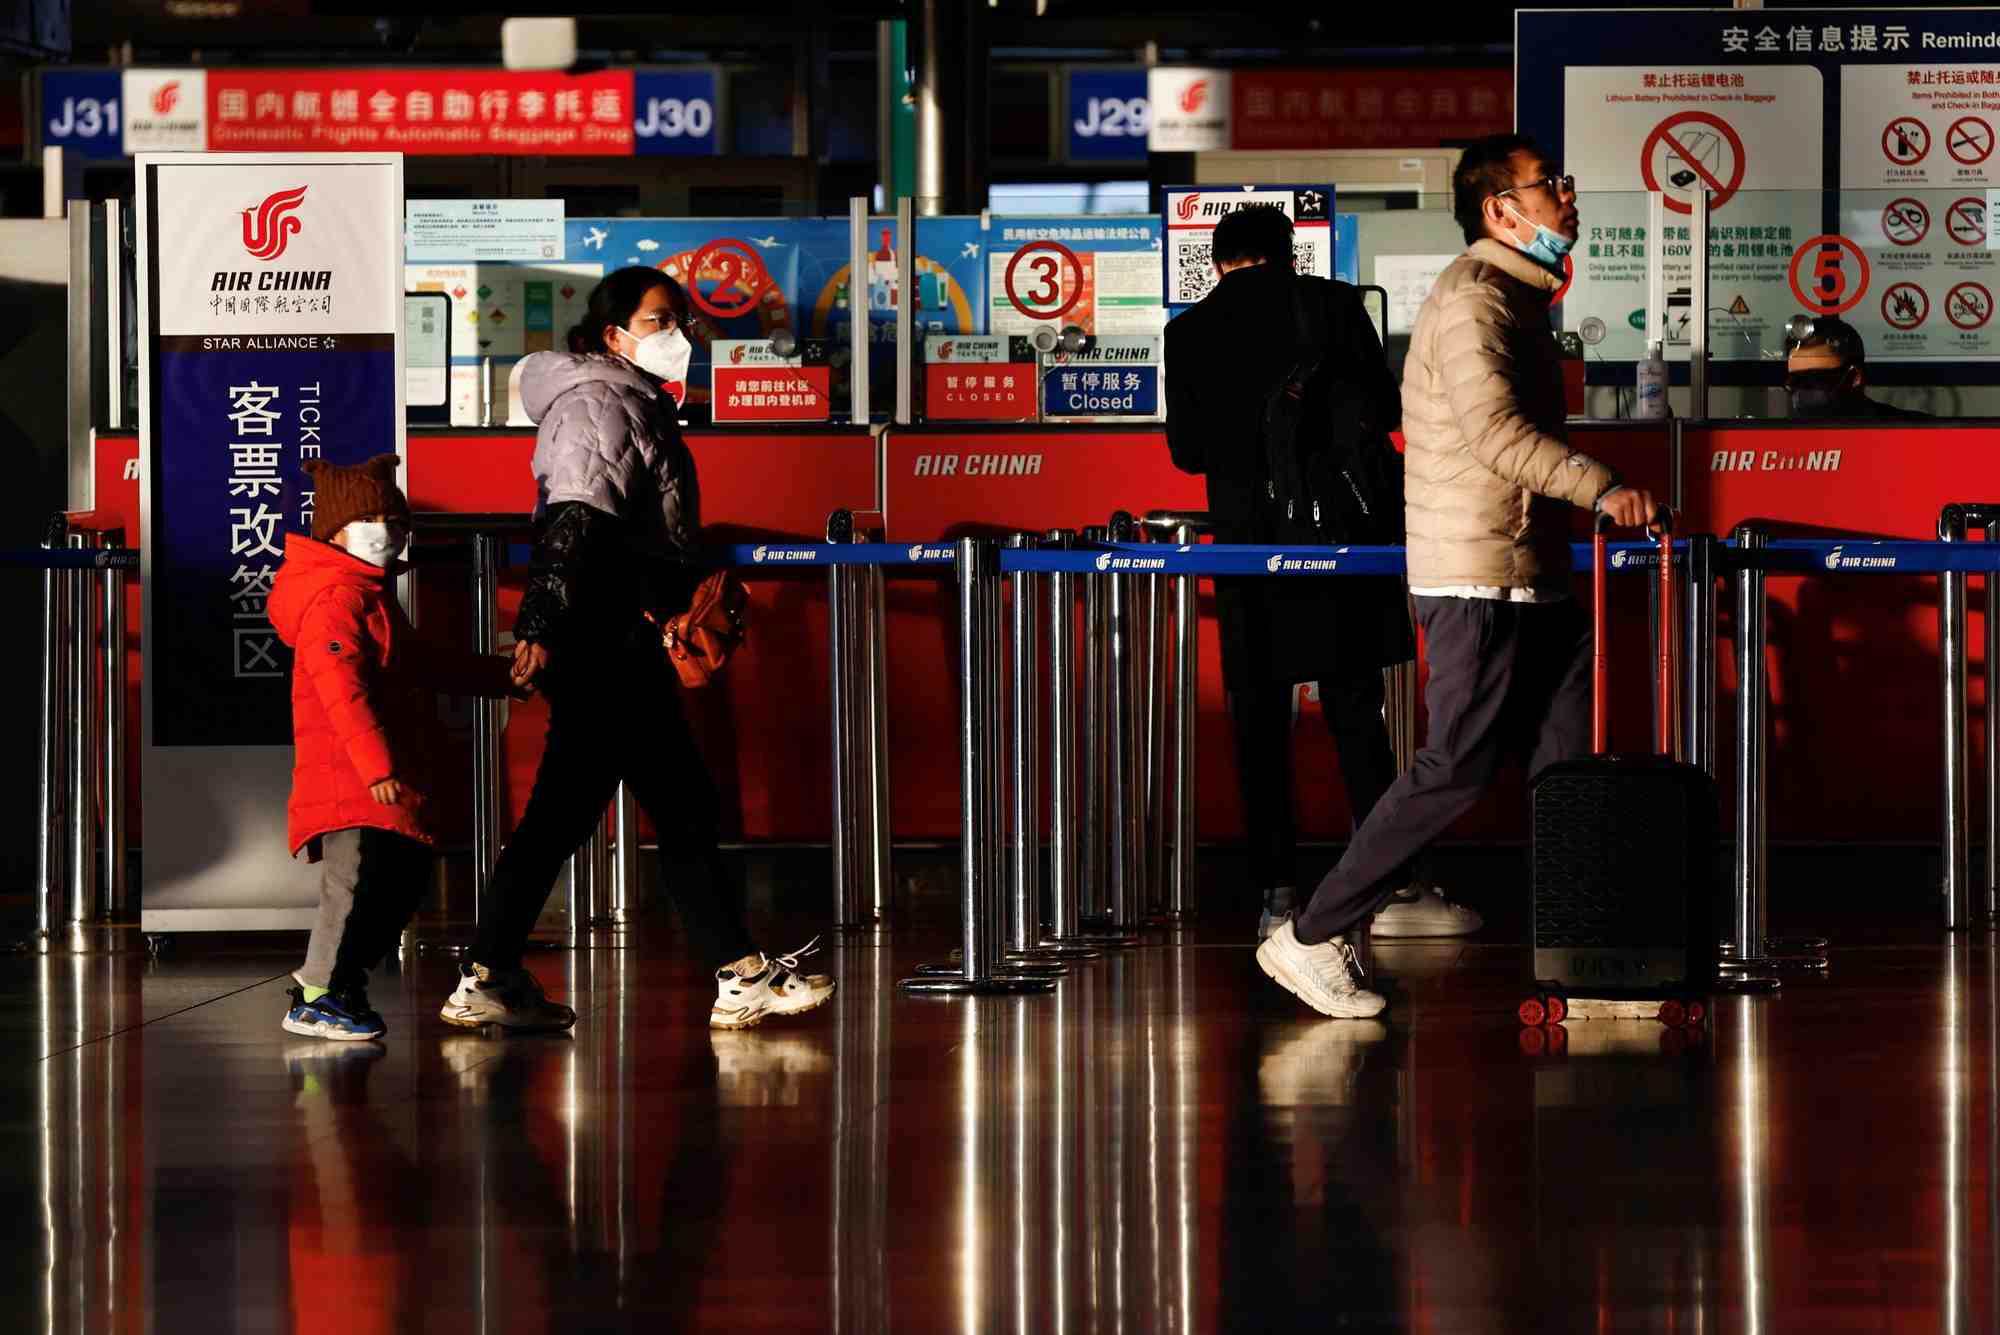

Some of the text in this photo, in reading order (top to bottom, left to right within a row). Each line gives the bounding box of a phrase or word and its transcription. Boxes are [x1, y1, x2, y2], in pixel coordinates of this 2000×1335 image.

[1722, 25, 1911, 52] 安全信息提示
[1643, 73, 1744, 88] 禁止托运锂电池
[1908, 70, 2000, 84] 禁止托运或随
[218, 88, 623, 122] 国内航班全自助行李托运
[1982, 102, 2000, 111] Bagg
[51, 97, 118, 137] J31
[634, 98, 712, 137] J30
[1074, 96, 1149, 137] J29
[1202, 202, 1230, 216] AIR
[211, 271, 332, 291] AIR CHINA
[1028, 256, 1059, 305] 3
[1812, 251, 1846, 301] 5
[203, 337, 318, 350] STAR ALLIANCE
[1105, 348, 1150, 360] CHINA
[1061, 373, 1141, 391] 暂停服务
[729, 394, 817, 406] 办理国内登机牌
[946, 393, 1015, 401] CLOSED
[1069, 393, 1133, 409] Closed
[299, 382, 321, 526] TICKE RE
[1711, 451, 1754, 472] AIR
[914, 454, 1042, 475] AIR CHINA
[228, 381, 284, 678] 客票改签区
[768, 550, 816, 560] AIR CHINA
[923, 549, 955, 559] AIR CH
[1628, 555, 1646, 565] AIR
[1111, 558, 1165, 569] AIR CHINA
[1282, 560, 1336, 570] AIR CHINA
[1842, 557, 1896, 568] AIR CHINA
